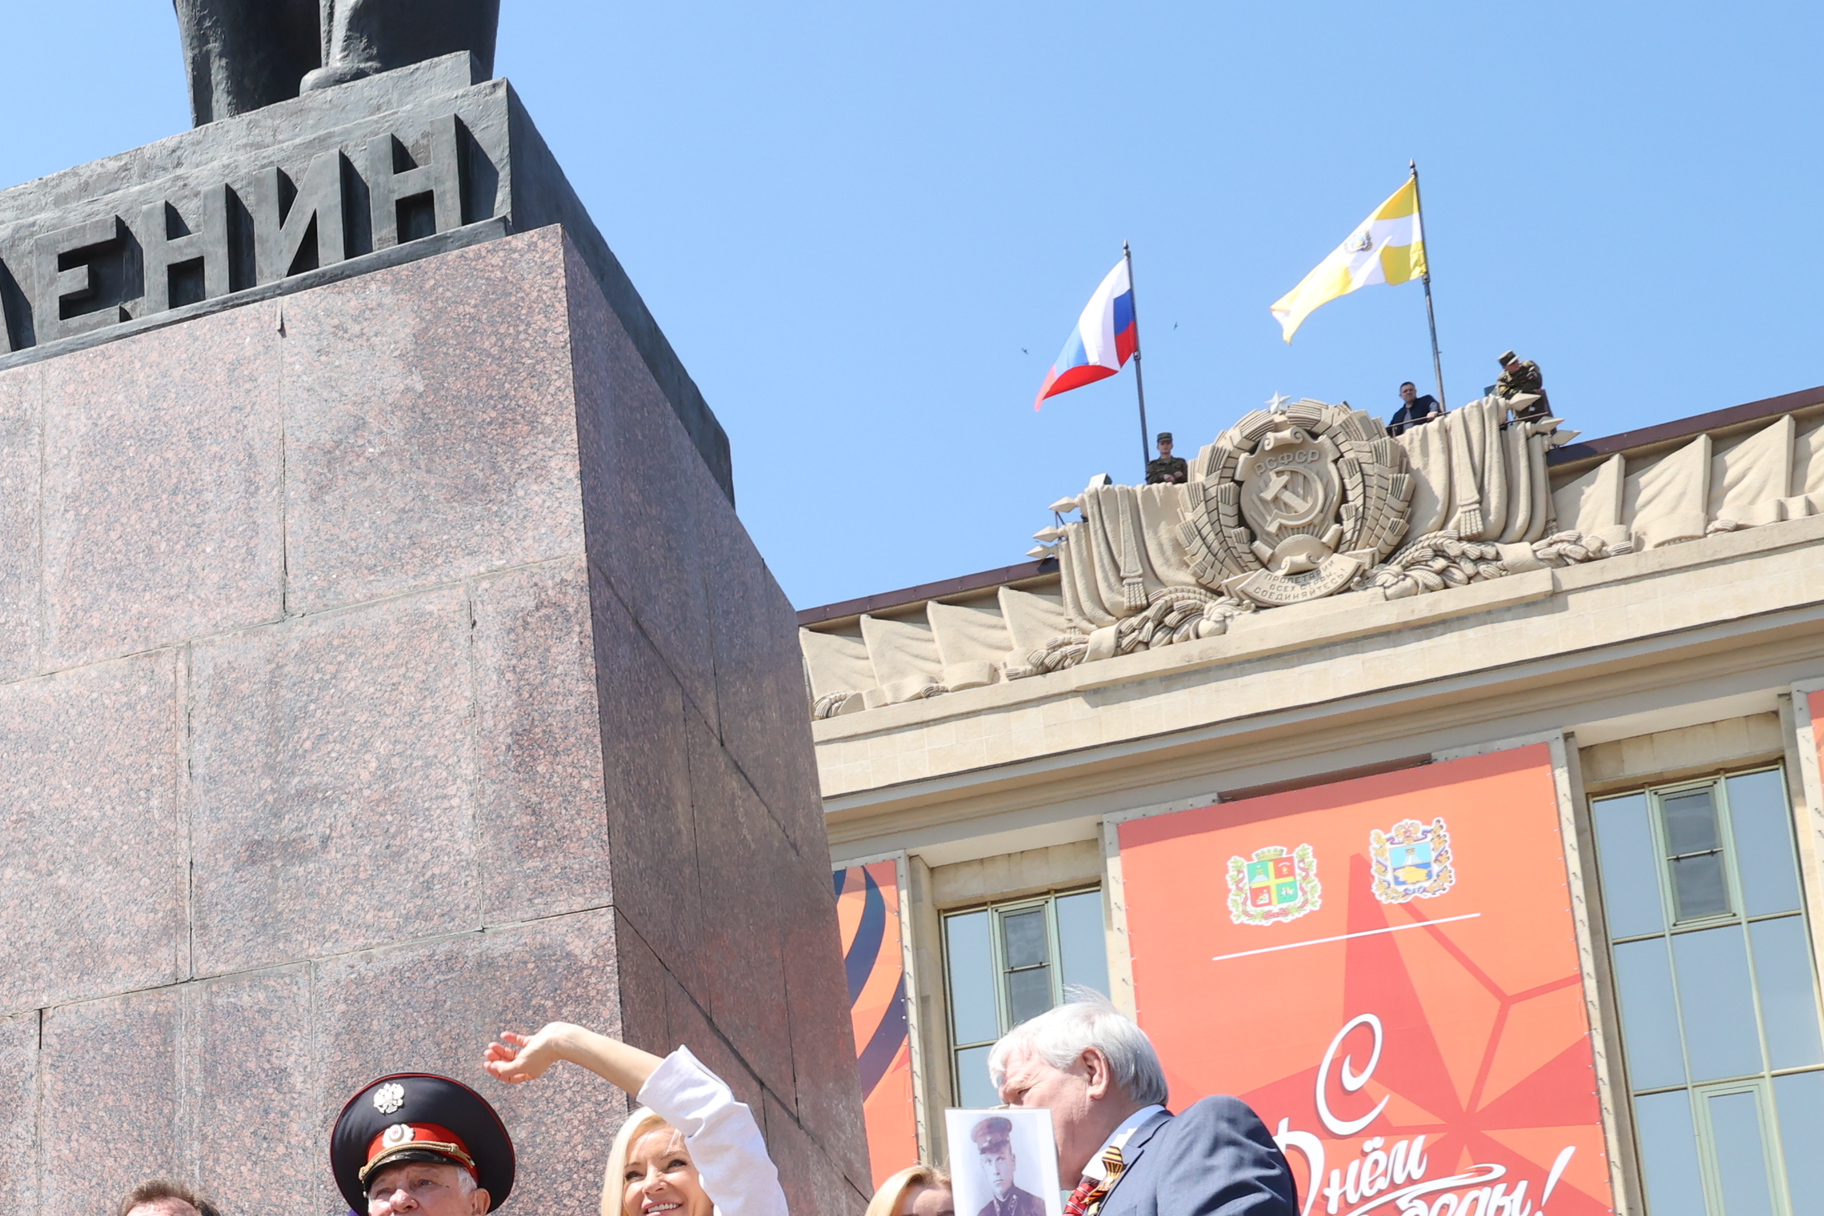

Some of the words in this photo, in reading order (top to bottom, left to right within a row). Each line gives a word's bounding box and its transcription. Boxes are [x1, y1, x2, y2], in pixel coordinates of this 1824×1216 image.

[1253, 449, 1321, 476] РСФСР
[1253, 568, 1349, 601] СОЕДИНЯЙТЕСЬ!
[1264, 559, 1335, 584] ПРОЛЕТАРИИ
[1269, 583, 1295, 592] ВСЕХ
[1315, 1013, 1390, 1136] С
